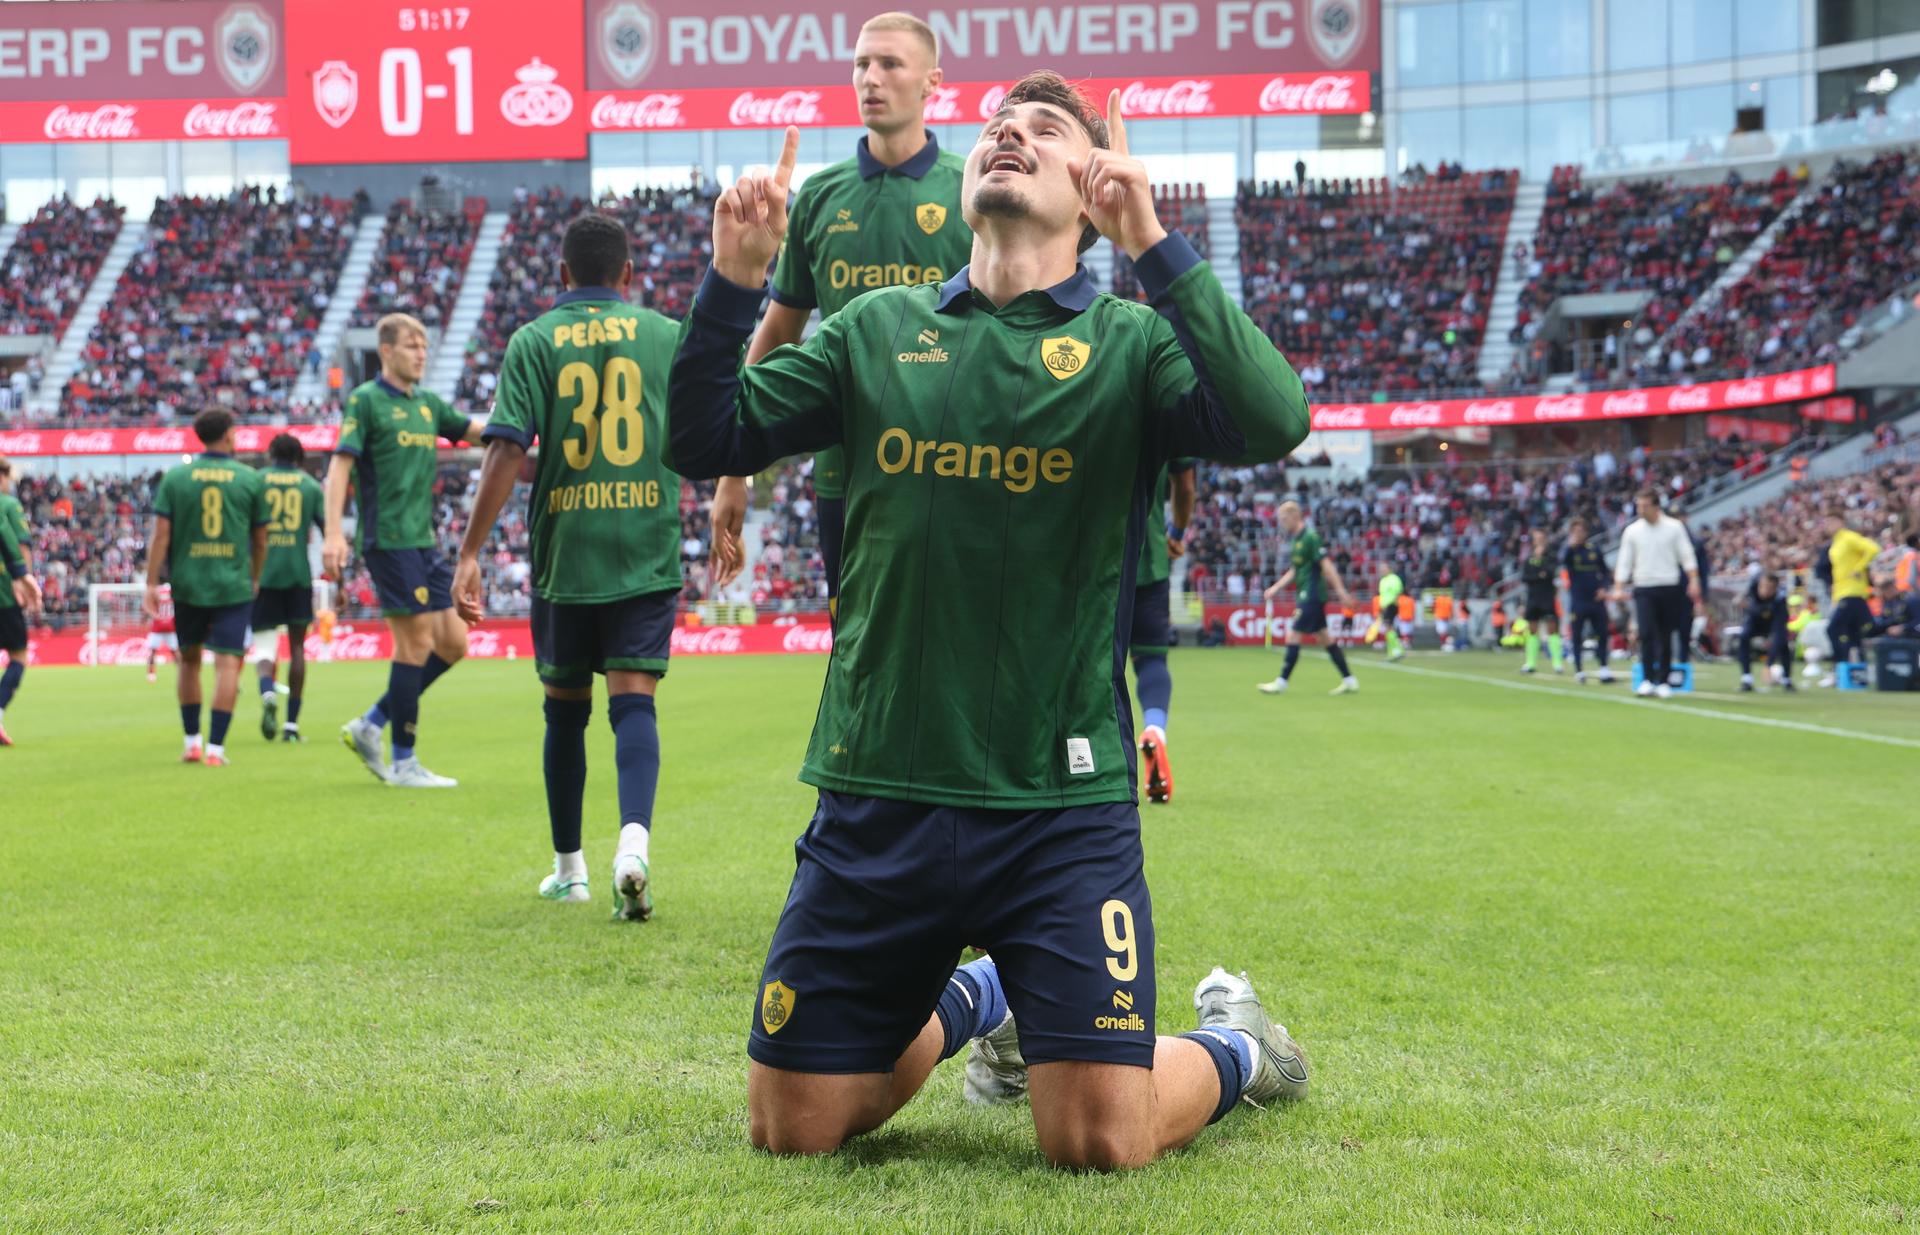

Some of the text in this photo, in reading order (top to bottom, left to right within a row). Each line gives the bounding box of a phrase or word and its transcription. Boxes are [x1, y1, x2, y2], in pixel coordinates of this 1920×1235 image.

[399, 7, 470, 31] 51:17
[669, 1, 1295, 65] ROYAL NTWERP FC
[128, 27, 205, 75] FC
[379, 47, 473, 136] 0-1
[830, 260, 943, 289] Orange
[554, 317, 638, 348] PEASY
[557, 357, 644, 470] 38
[877, 428, 1073, 492] Orange
[202, 485, 223, 539] 8
[264, 487, 302, 532] 29
[1101, 899, 1138, 981] 9
